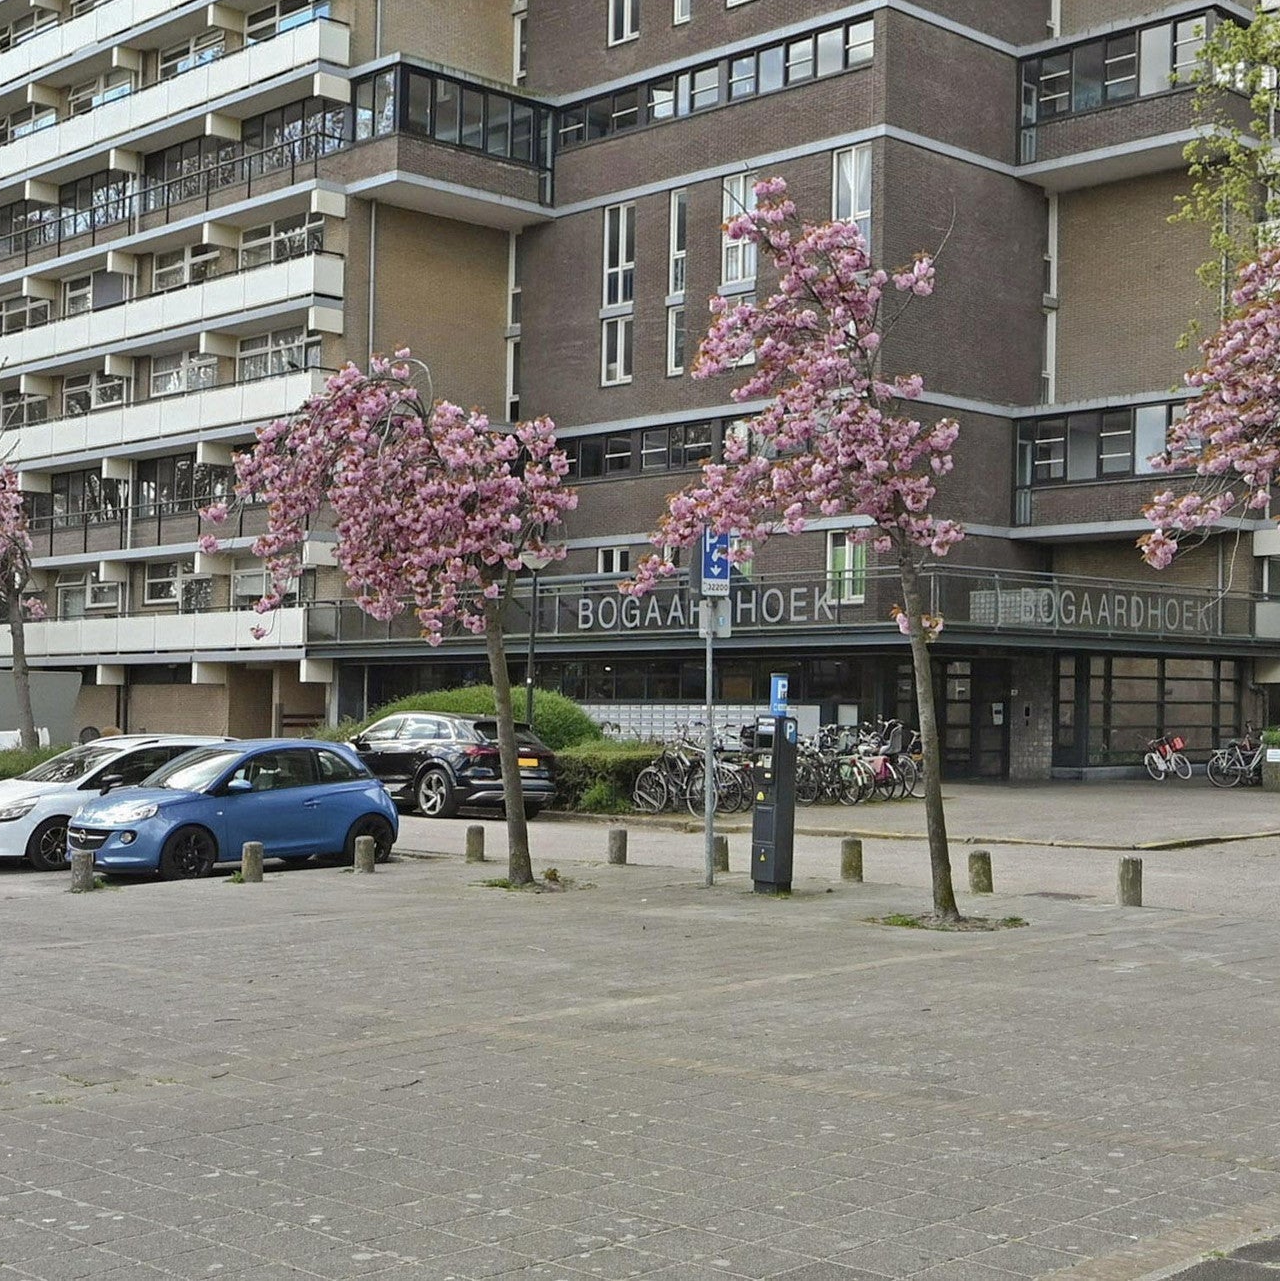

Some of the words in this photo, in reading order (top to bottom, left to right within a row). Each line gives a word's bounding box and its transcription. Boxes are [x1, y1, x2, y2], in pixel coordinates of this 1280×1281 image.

[706, 526, 719, 553] P
[578, 587, 834, 630] BOGAAHOEK
[1020, 587, 1210, 631] BOGAARDHOEK
[778, 680, 788, 699] P
[786, 722, 795, 740] P
